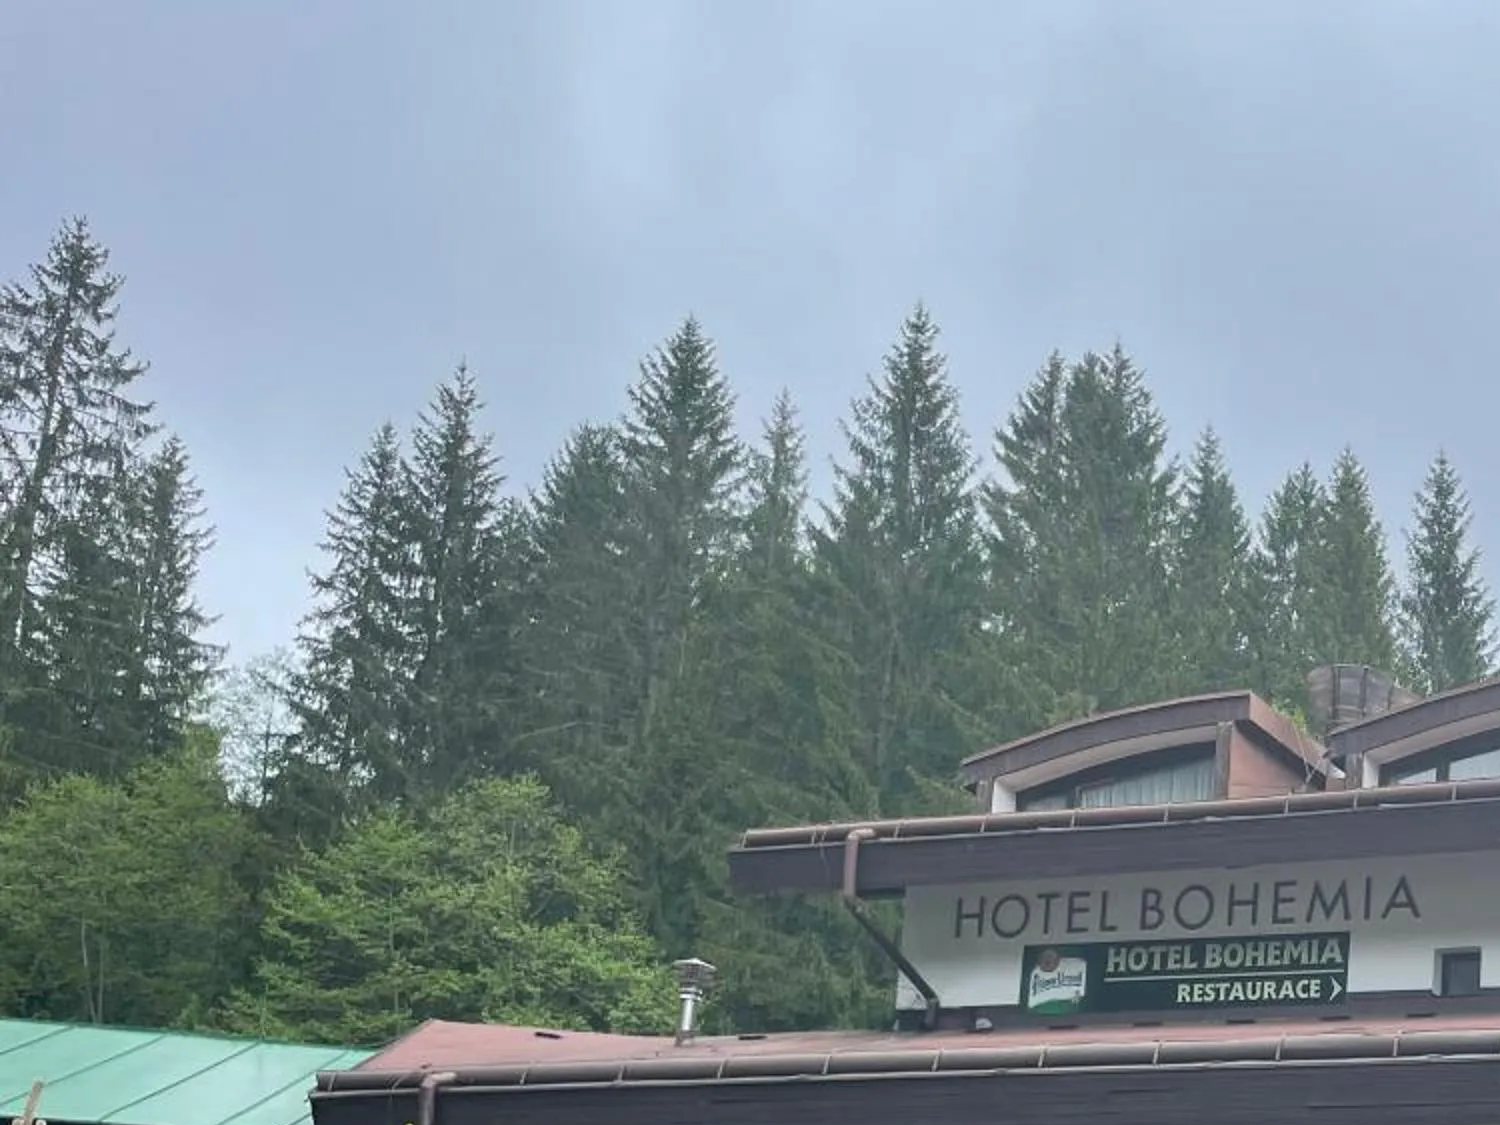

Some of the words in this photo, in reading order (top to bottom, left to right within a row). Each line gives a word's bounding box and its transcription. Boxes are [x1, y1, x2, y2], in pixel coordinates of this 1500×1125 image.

[955, 889, 1118, 938] HOTEL
[1139, 876, 1422, 932] BOHEMIA
[1106, 944, 1198, 973] HOTEL
[1204, 938, 1344, 969] BOHEMIA
[1176, 979, 1321, 1003] RESTAURACE
